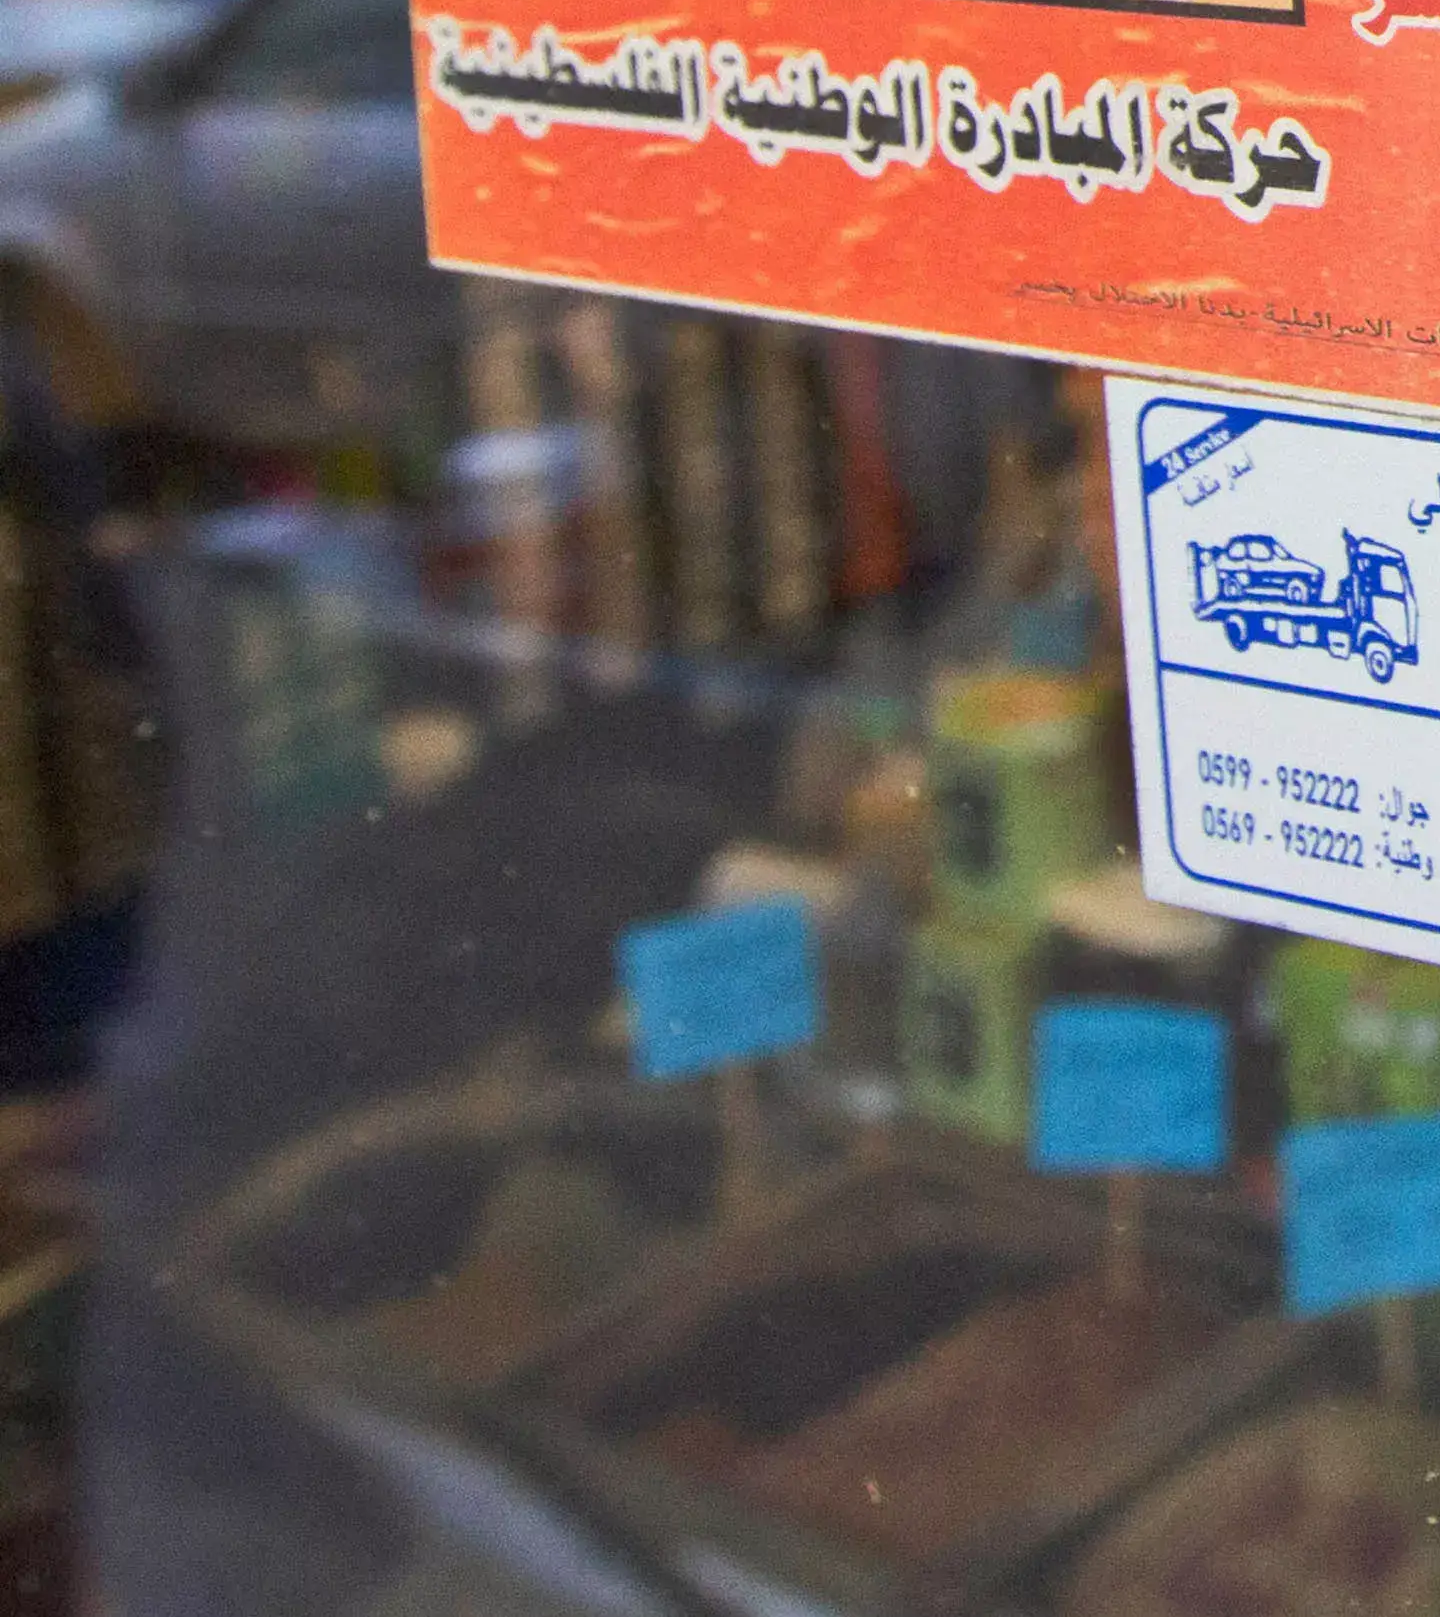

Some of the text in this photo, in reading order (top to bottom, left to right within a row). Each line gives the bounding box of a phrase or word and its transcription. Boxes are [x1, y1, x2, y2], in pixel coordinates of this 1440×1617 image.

[432, 24, 1321, 210] حركة المبادرة الوطنية الفلسطينية
[1160, 449, 1185, 479] 24
[1198, 749, 1252, 790] 0599
[1276, 765, 1361, 813] 952222
[1202, 804, 1256, 845] 0569
[1378, 787, 1430, 828] جوال:
[1280, 819, 1364, 869] 952222
[1375, 831, 1434, 881] وطنية:
